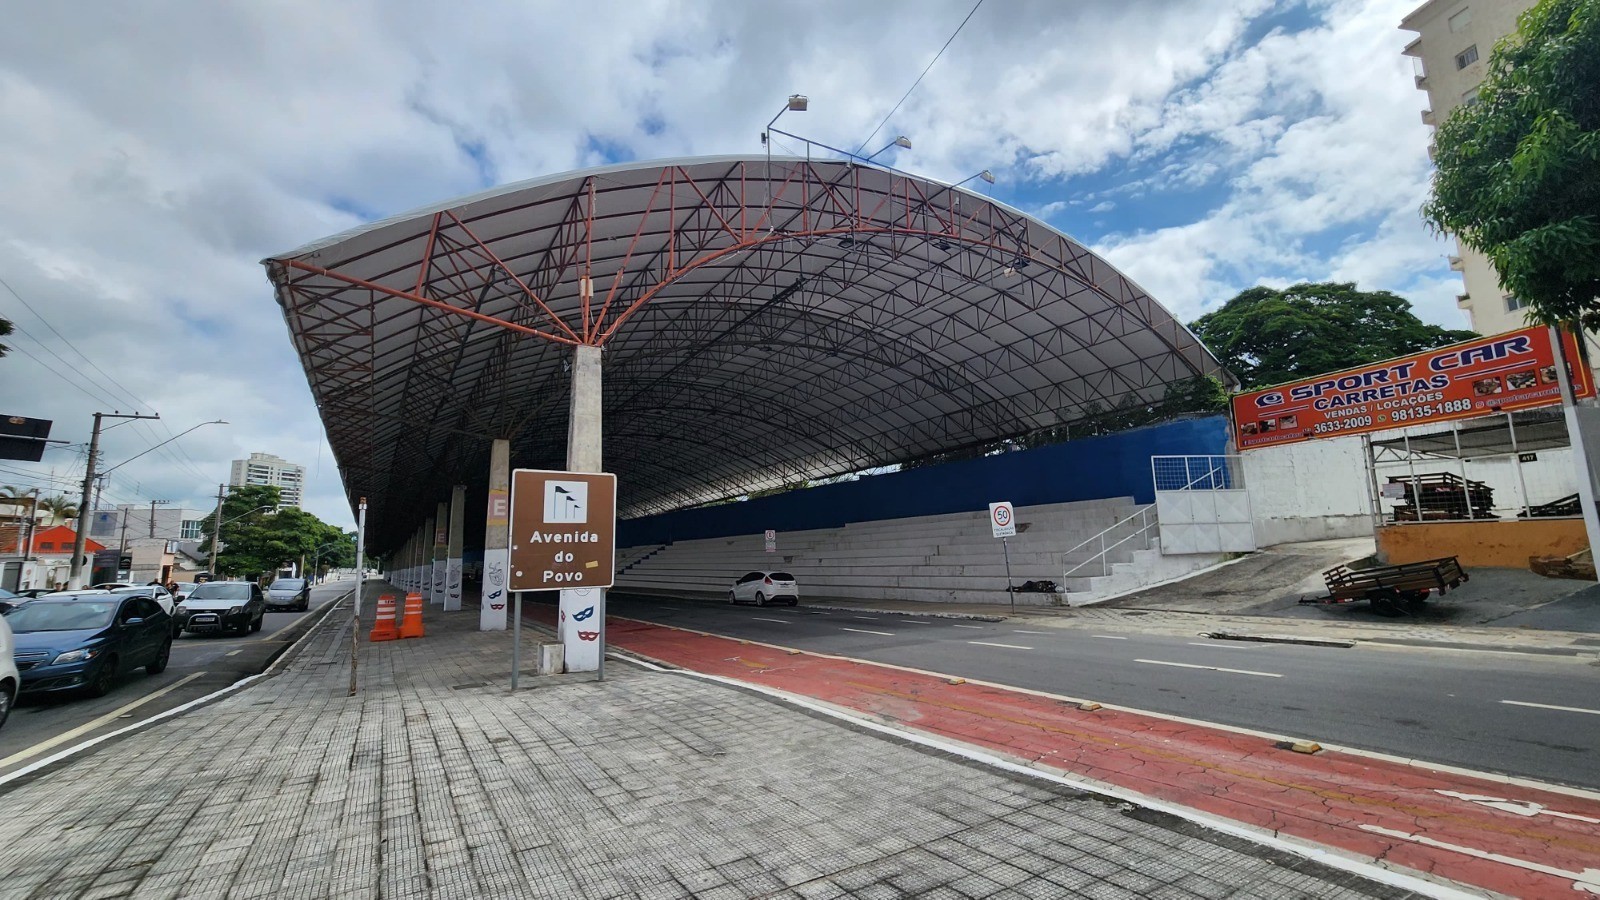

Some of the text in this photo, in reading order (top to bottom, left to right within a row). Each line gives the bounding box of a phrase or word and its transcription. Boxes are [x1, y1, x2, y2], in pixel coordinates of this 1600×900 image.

[1290, 335, 1533, 401] SPORT CAR
[1313, 374, 1450, 411] CARRETAS
[1323, 405, 1367, 419] VENDAS
[1376, 391, 1443, 411] LOCAÇÕES
[1313, 415, 1372, 433] 3633-2009
[1391, 398, 1472, 422] 98135-1888
[494, 499, 506, 516] E
[997, 510, 1008, 520] 50
[530, 530, 599, 544] Avenida
[554, 550, 574, 563] do
[542, 570, 583, 583] Povo
